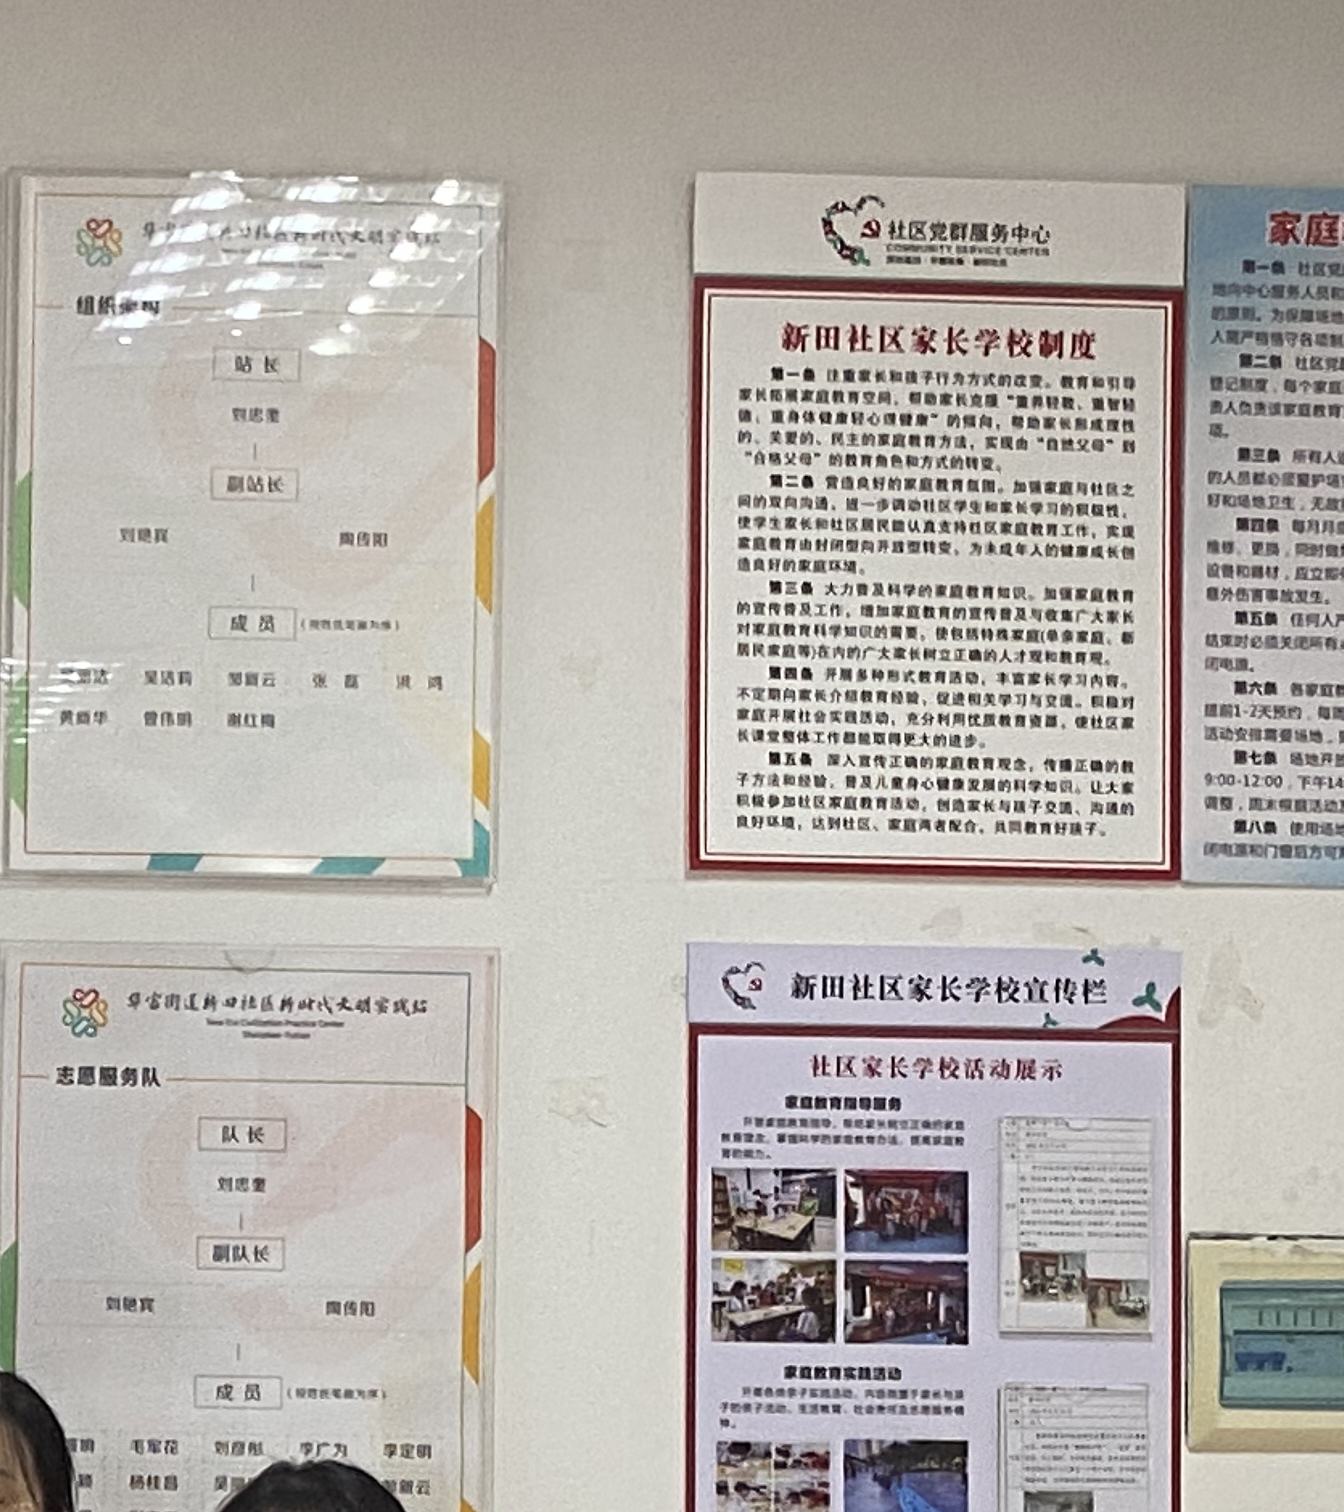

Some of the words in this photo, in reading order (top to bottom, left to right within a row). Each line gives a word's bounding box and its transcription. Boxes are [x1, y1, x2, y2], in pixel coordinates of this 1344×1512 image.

[887, 219, 1051, 245] 社区党群服务中心
[1268, 210, 1344, 247] 家庭
[781, 321, 1098, 361] 新田社区家长学校制度
[790, 971, 1108, 1006] 新田社区家长学校宣传栏
[55, 1066, 162, 1088] 志愿服务队
[810, 1054, 1065, 1082] 社区家长学校活动展示
